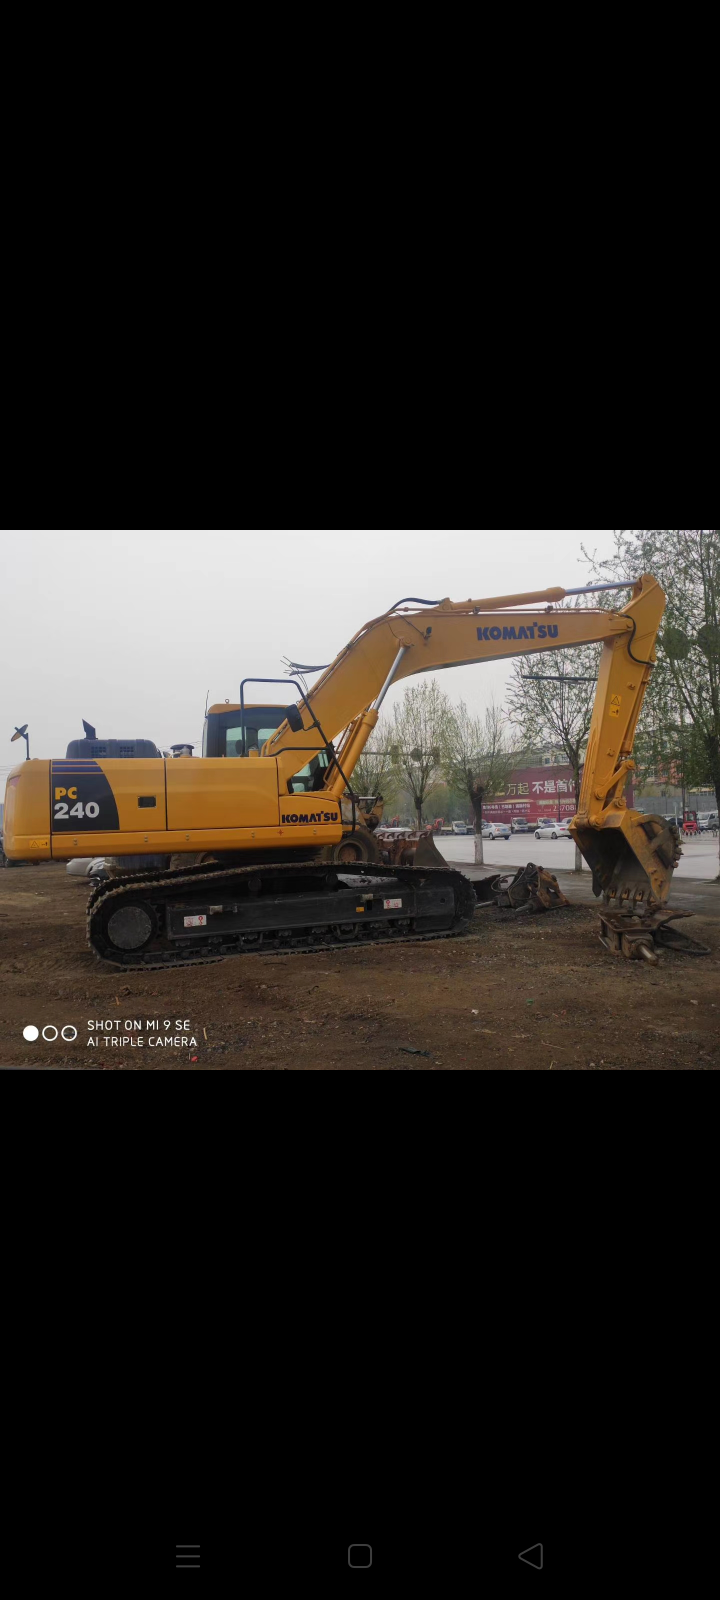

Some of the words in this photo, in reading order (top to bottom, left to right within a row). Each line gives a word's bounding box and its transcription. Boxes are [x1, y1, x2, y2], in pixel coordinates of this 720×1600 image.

[476, 621, 559, 641] KOMATSU
[54, 786, 78, 800] PC
[53, 801, 100, 819] 240
[281, 810, 338, 824] KOMATSU
